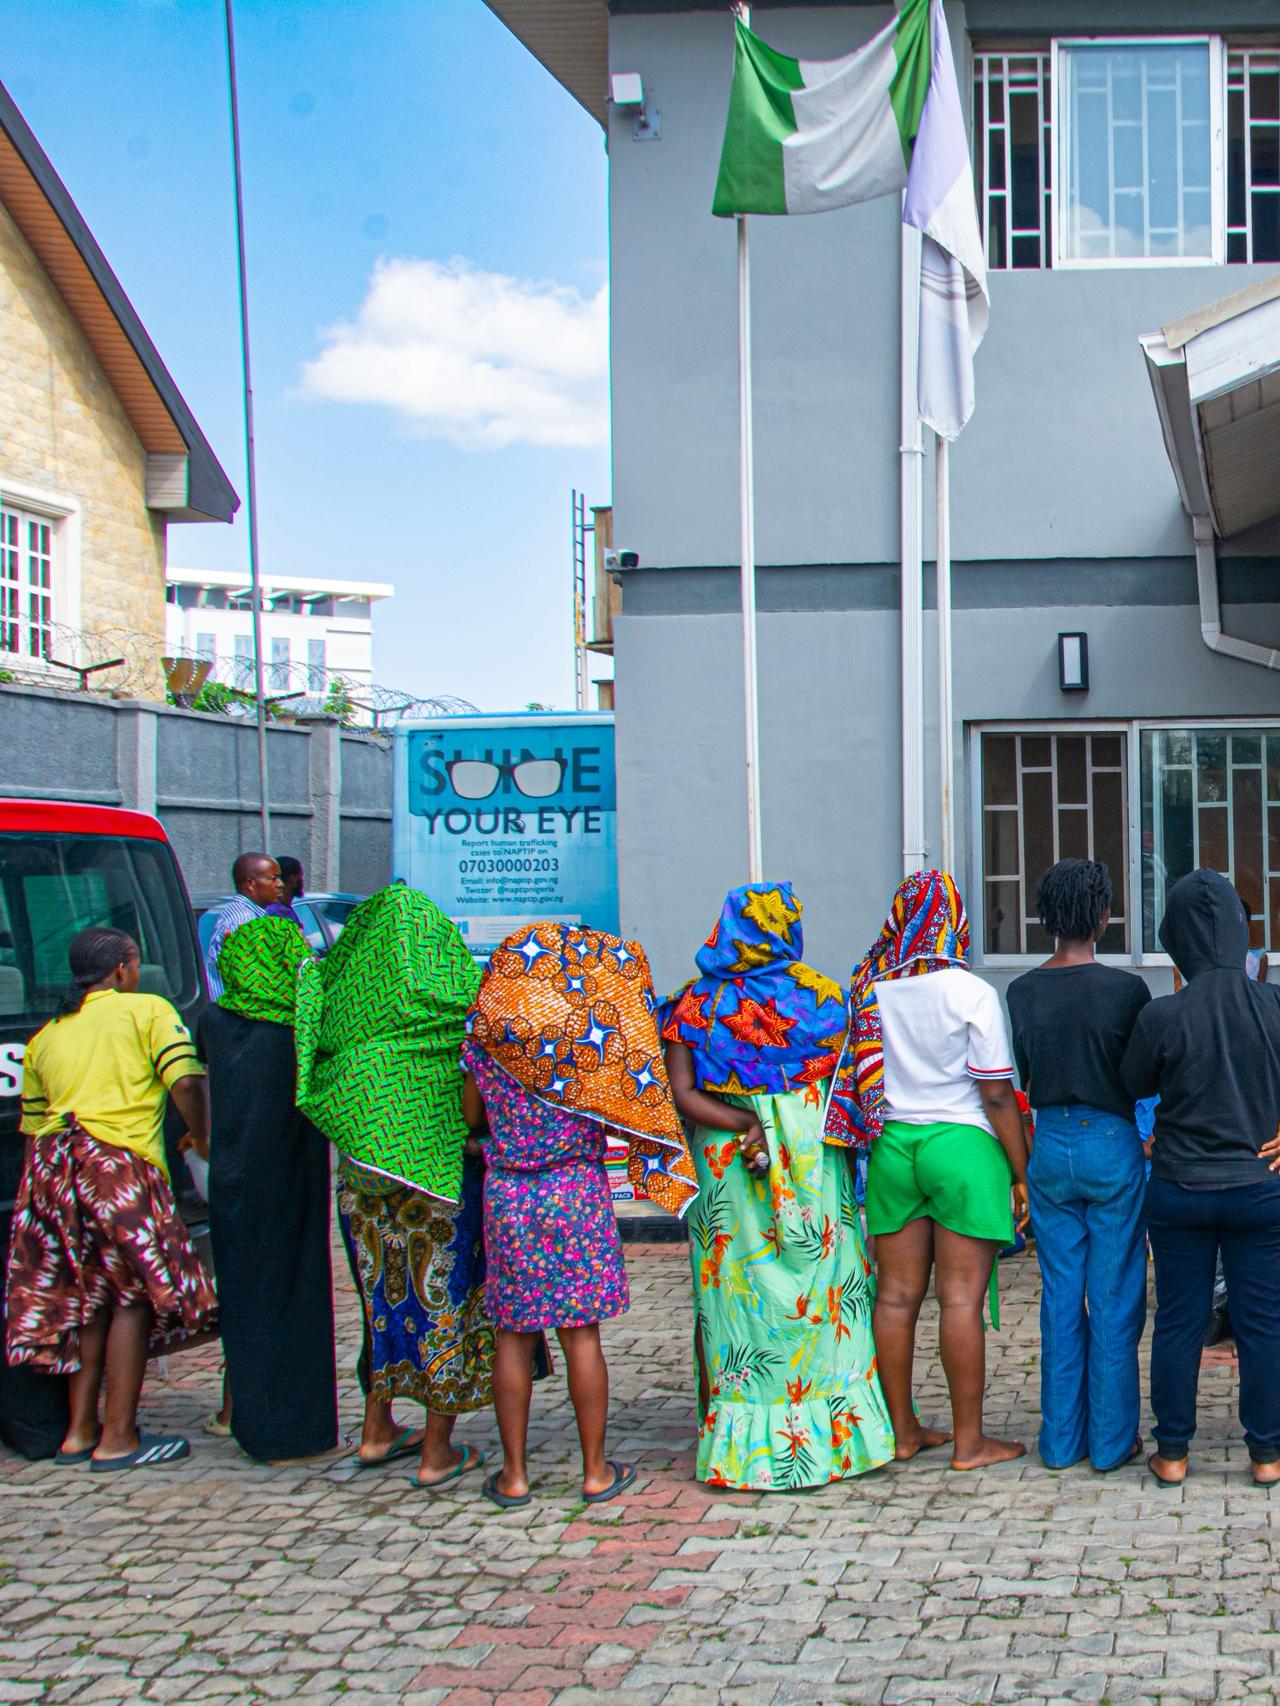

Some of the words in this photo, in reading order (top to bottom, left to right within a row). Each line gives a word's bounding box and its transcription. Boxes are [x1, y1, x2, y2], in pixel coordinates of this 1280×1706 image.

[419, 747, 601, 795] SIE
[420, 806, 526, 835] YOUR
[537, 805, 602, 834] EYE
[461, 839, 489, 848] Report
[519, 838, 558, 848] trafficking
[459, 858, 559, 873] 07030000203
